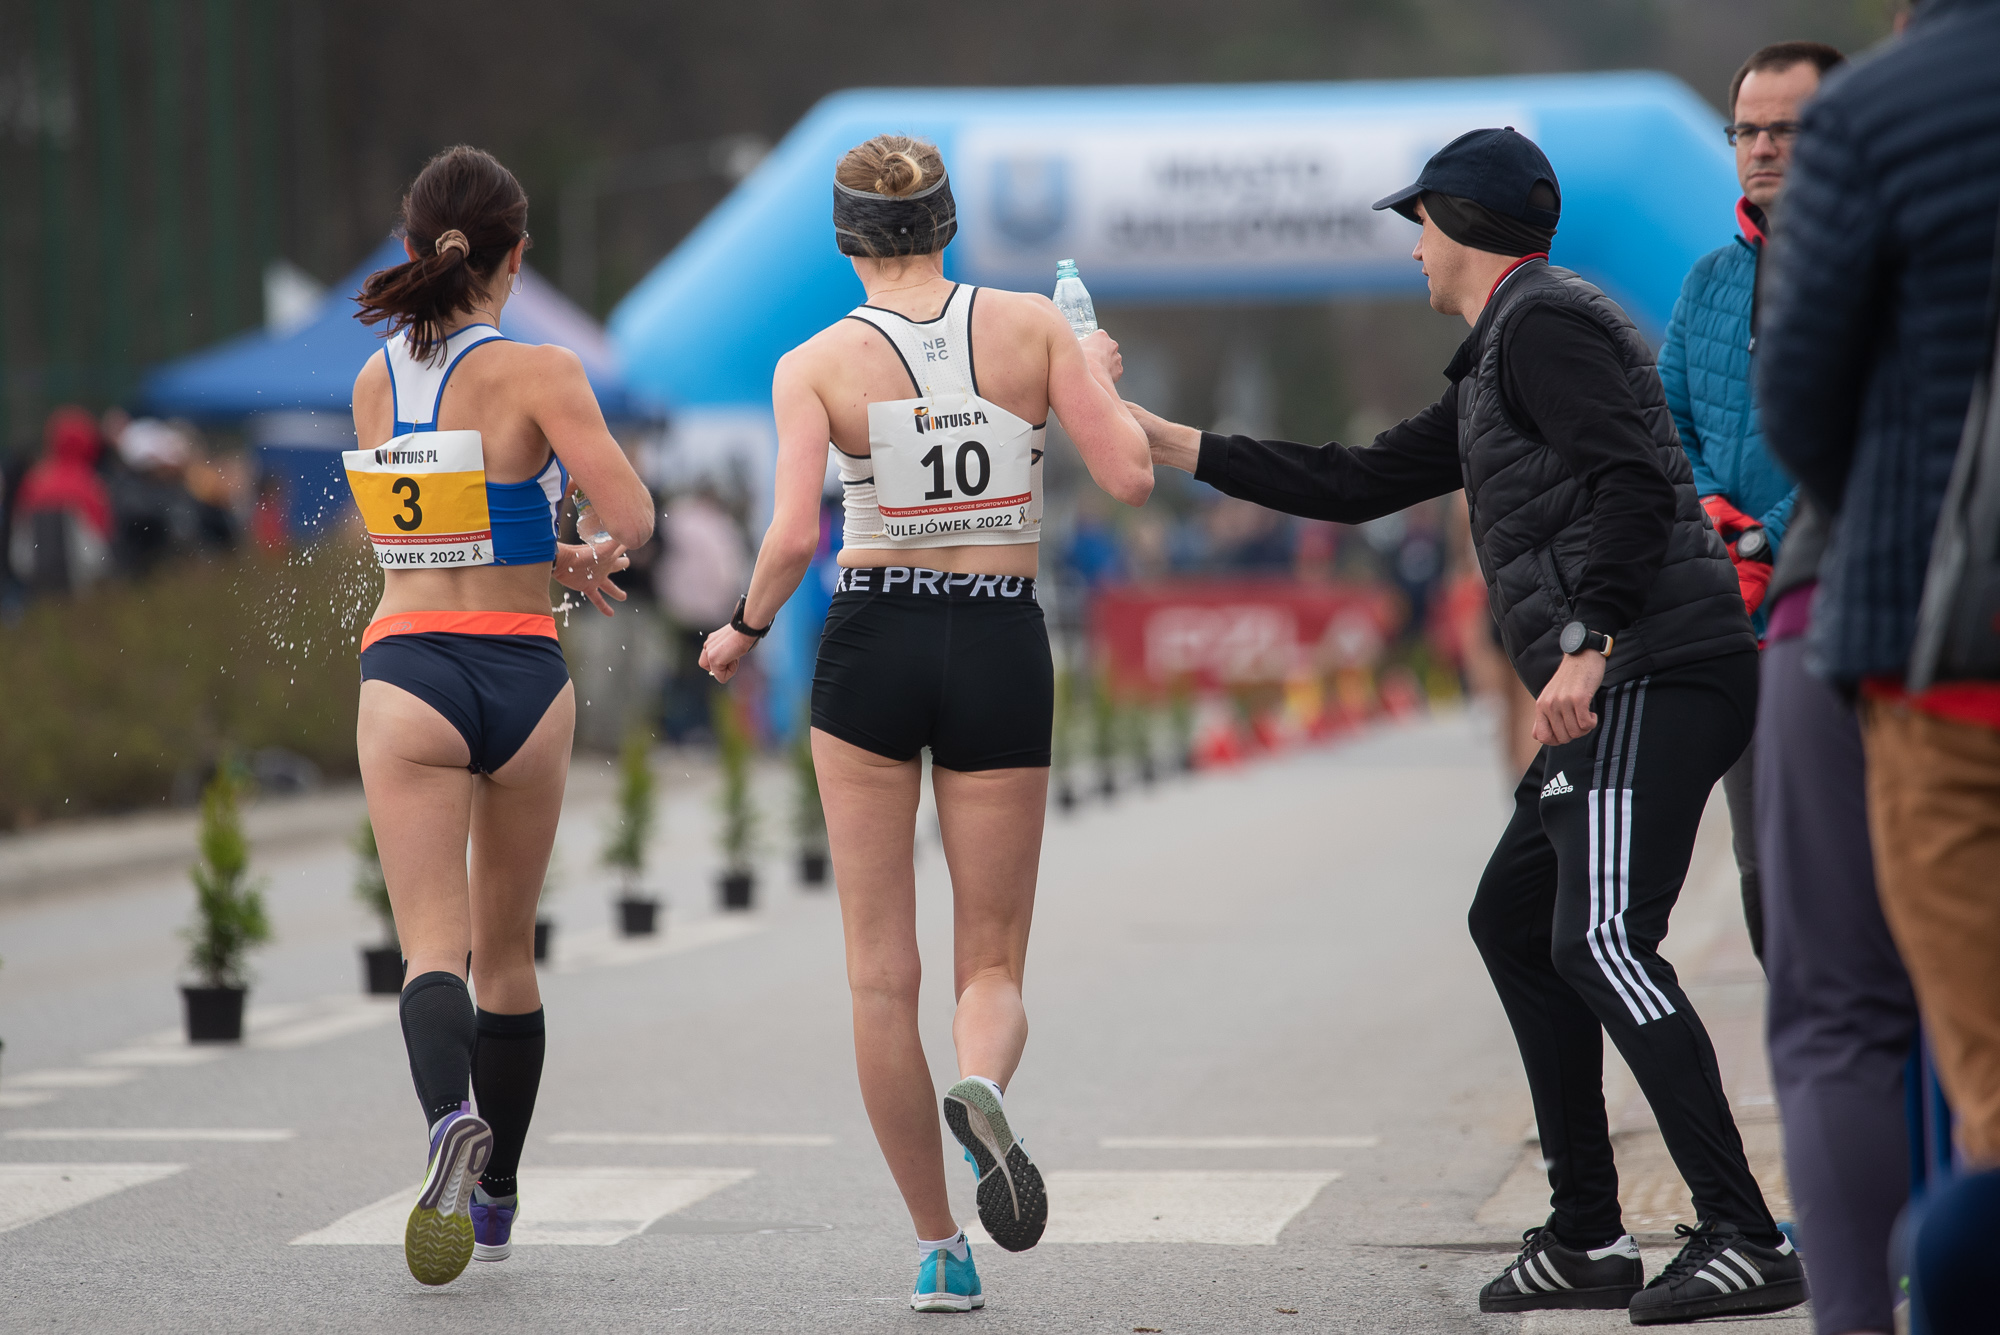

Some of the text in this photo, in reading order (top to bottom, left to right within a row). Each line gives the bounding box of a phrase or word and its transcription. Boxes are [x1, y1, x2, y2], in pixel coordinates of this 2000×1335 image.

[388, 450, 438, 465] INTUIS.PL
[920, 440, 991, 501] 10
[392, 477, 423, 531] 3
[976, 514, 1013, 529] 2022
[430, 550, 466, 563] 2022
[1540, 784, 1574, 799] adidas
